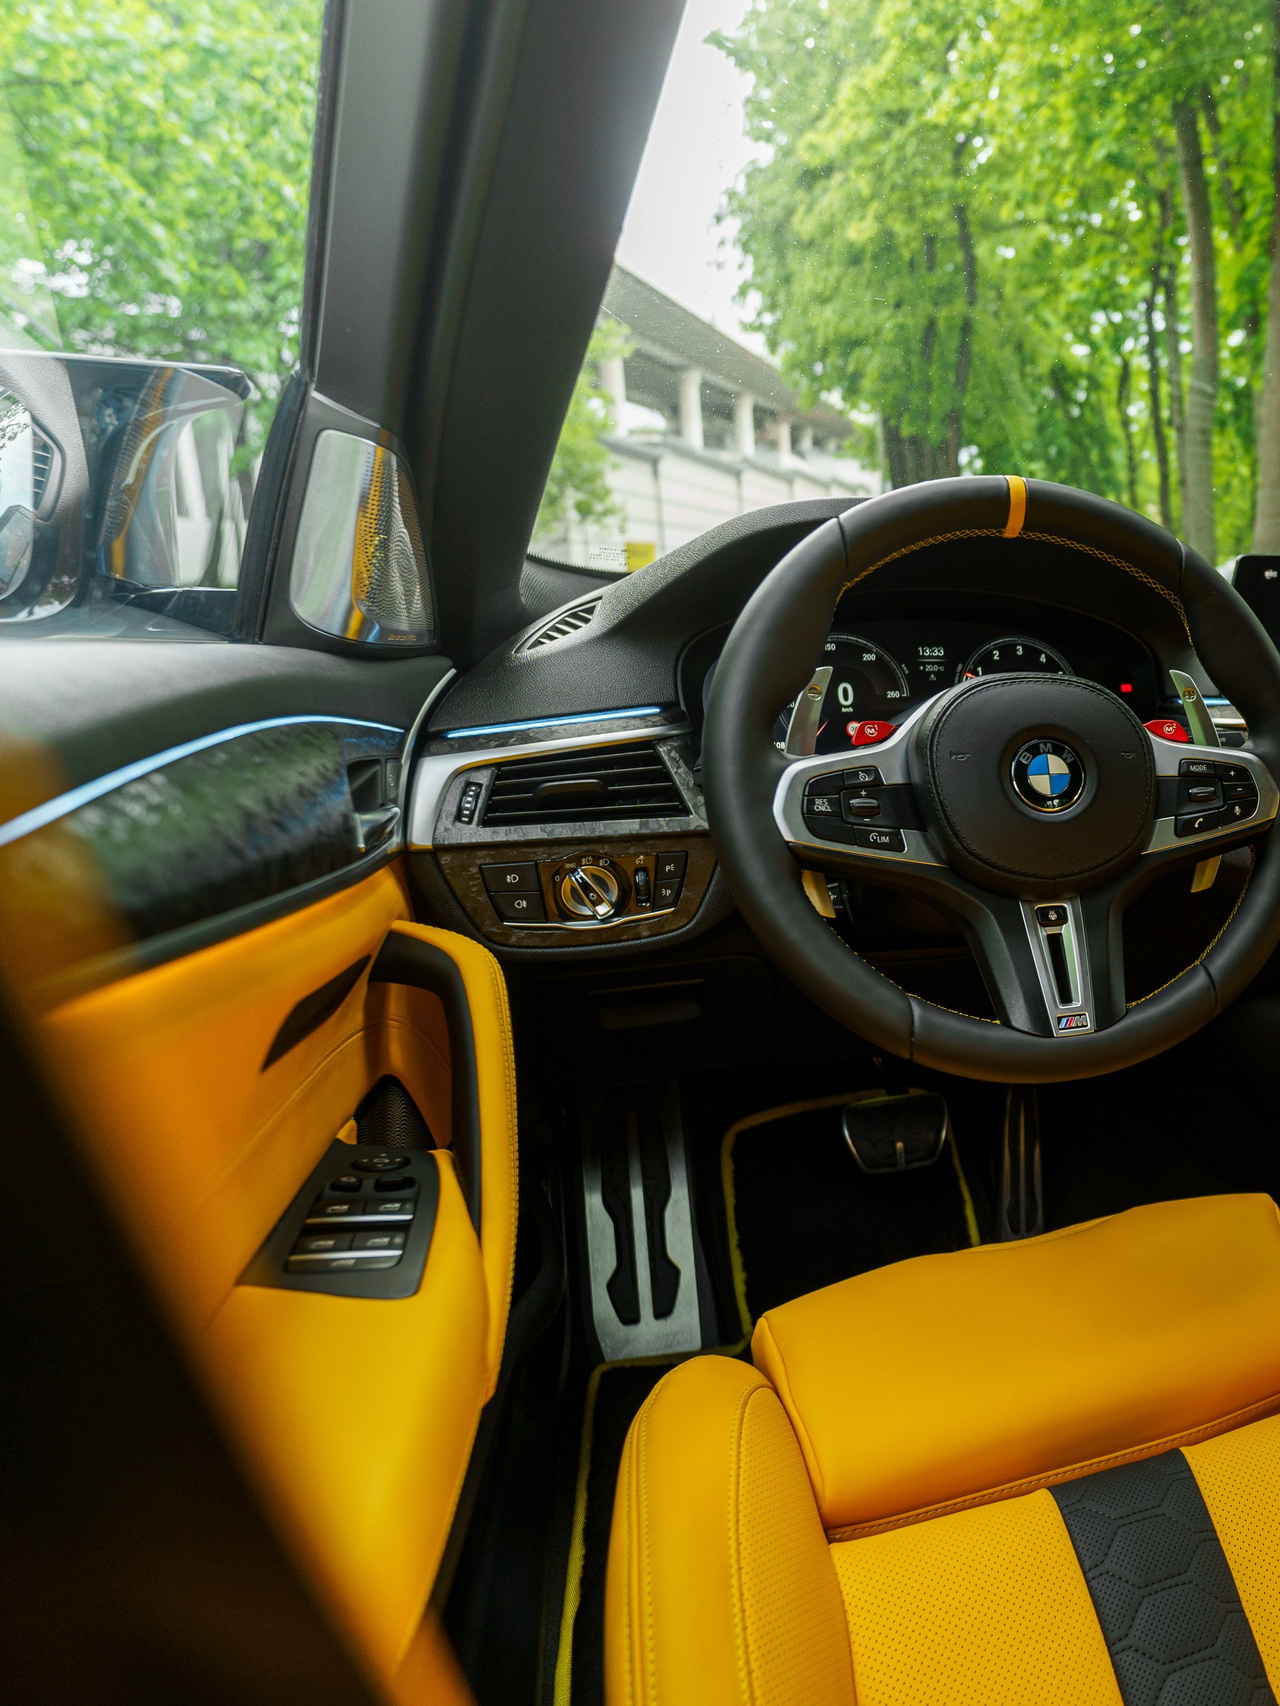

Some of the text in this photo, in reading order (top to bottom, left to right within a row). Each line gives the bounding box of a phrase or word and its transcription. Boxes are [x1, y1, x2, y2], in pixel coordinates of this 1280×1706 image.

[918, 646, 945, 656] 13:33
[1016, 646, 1023, 655] 3
[993, 651, 1000, 660] 2
[1040, 654, 1046, 663] 4
[977, 667, 982, 676] 1
[838, 682, 854, 706] 0
[1019, 743, 1075, 764] BMW
